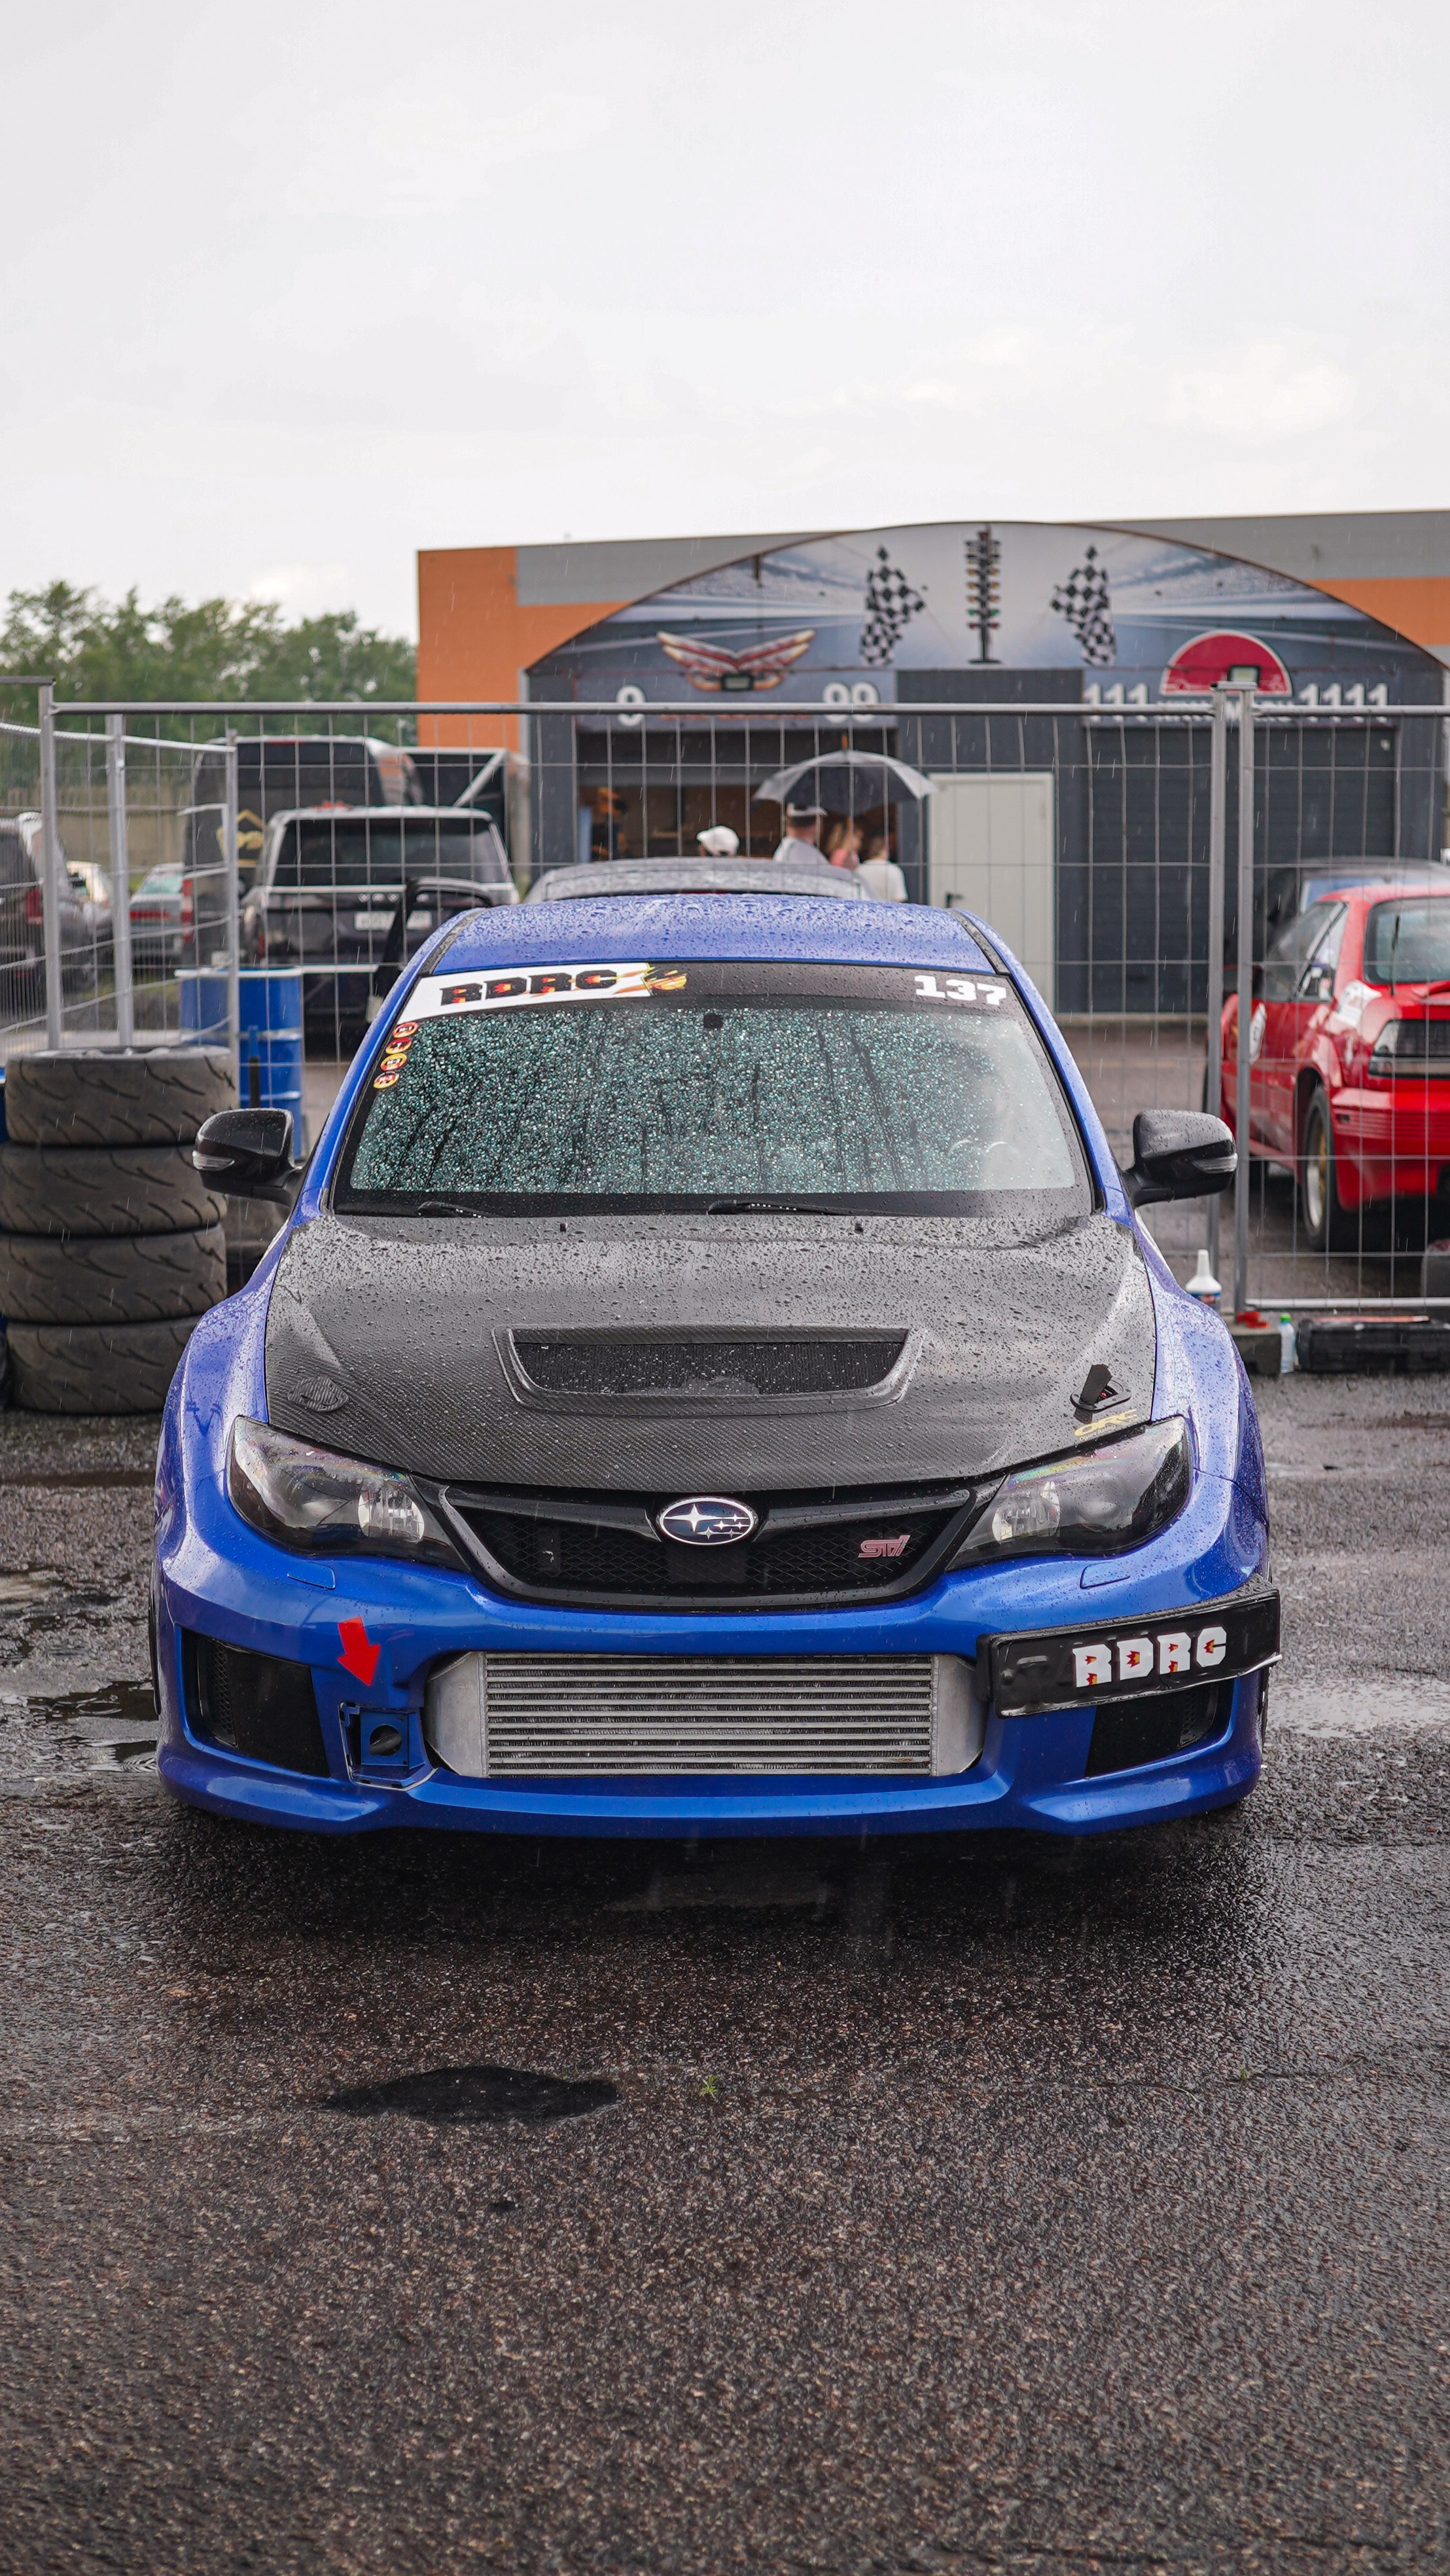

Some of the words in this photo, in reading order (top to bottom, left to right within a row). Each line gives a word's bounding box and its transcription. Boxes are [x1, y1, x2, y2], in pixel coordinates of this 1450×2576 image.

[1299, 683, 1388, 724] 1111
[440, 969, 617, 1006] RDRC
[914, 975, 1007, 1006] 137
[1074, 1408, 1137, 1437] ORC
[1072, 1626, 1228, 1689] RDRC
